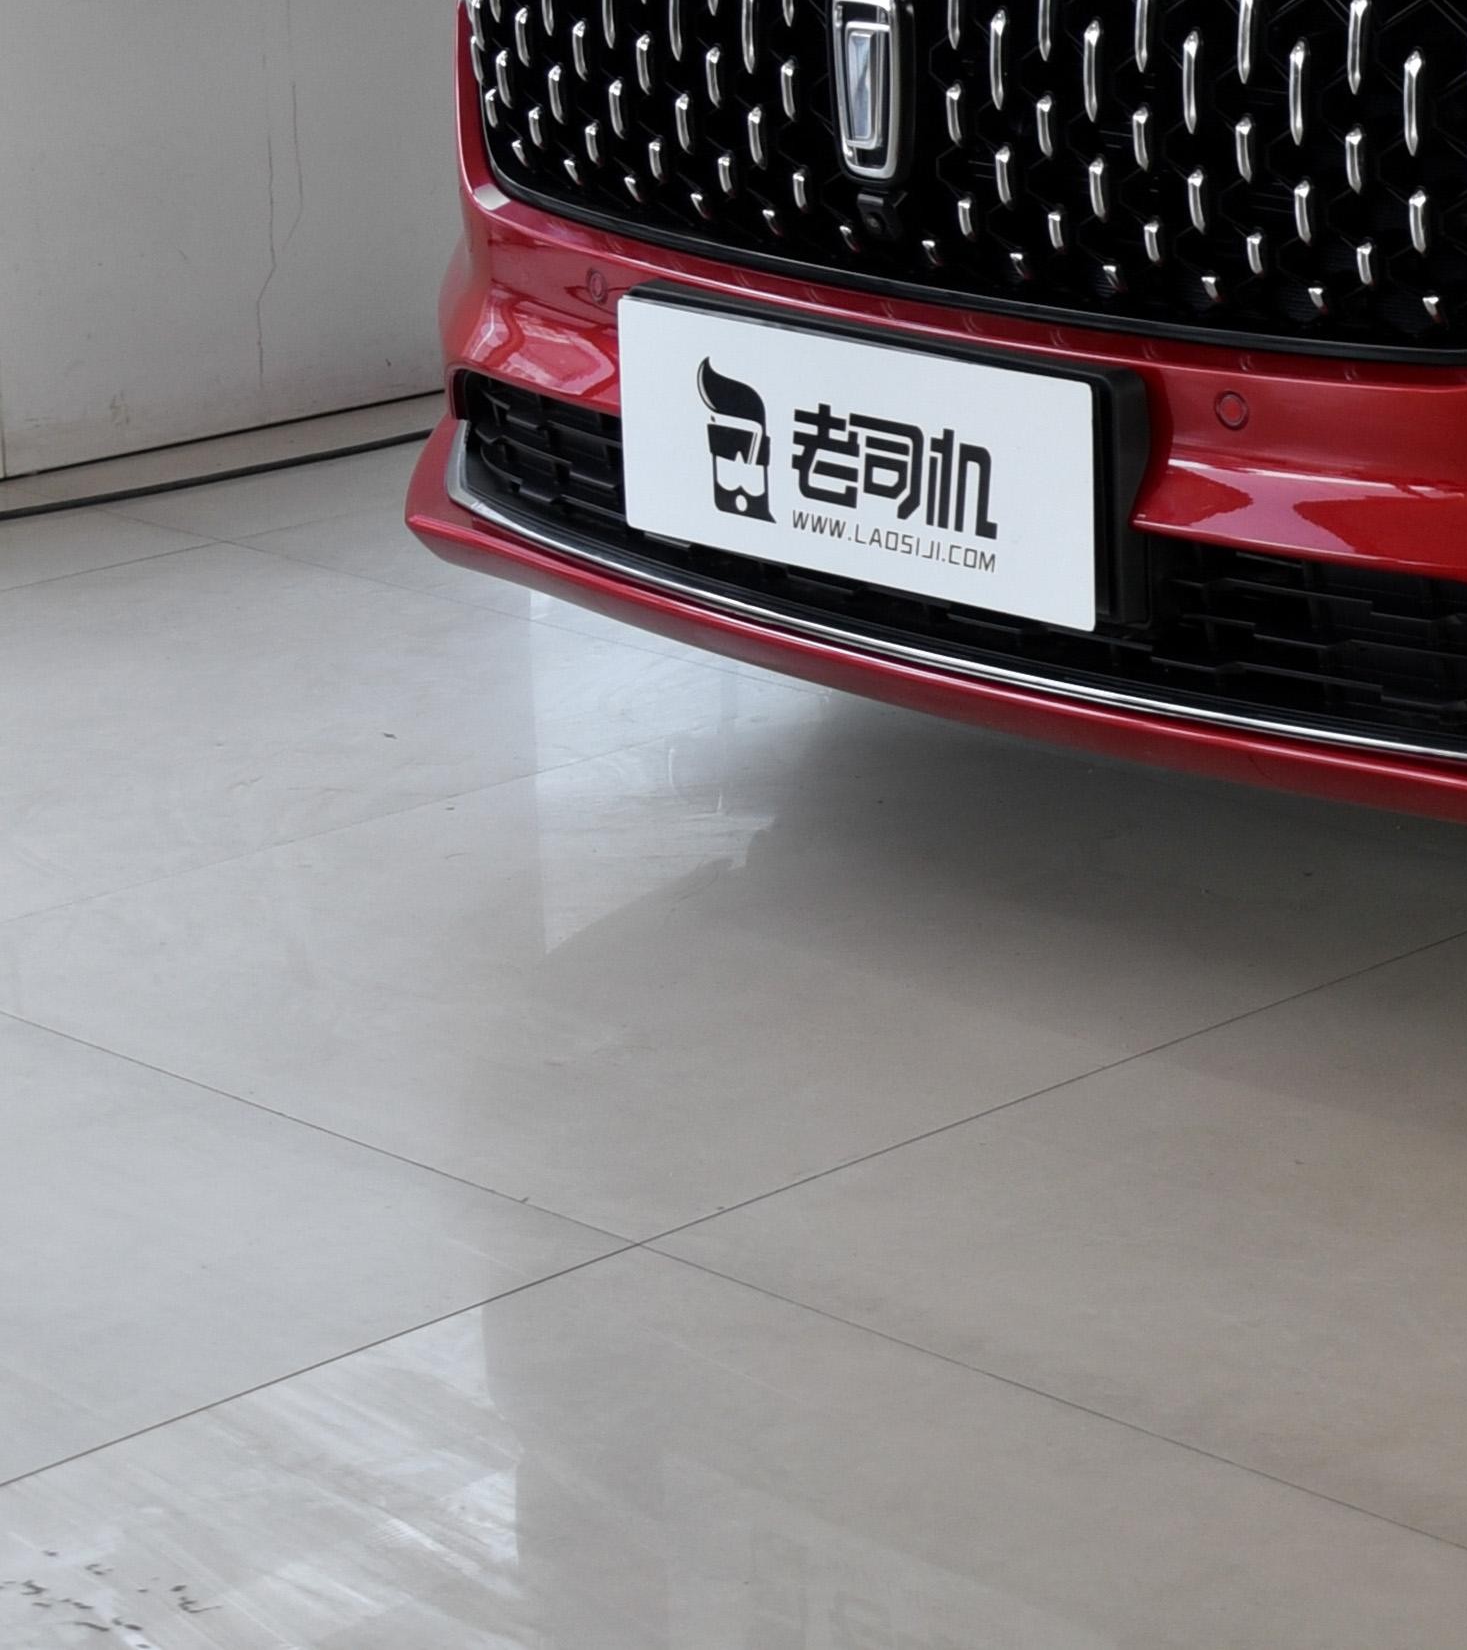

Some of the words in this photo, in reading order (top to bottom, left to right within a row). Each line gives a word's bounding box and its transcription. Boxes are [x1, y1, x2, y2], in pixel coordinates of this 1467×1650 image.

[792, 403, 998, 540] 老司机
[792, 509, 997, 574] WWW.LAOSIJI.COM
